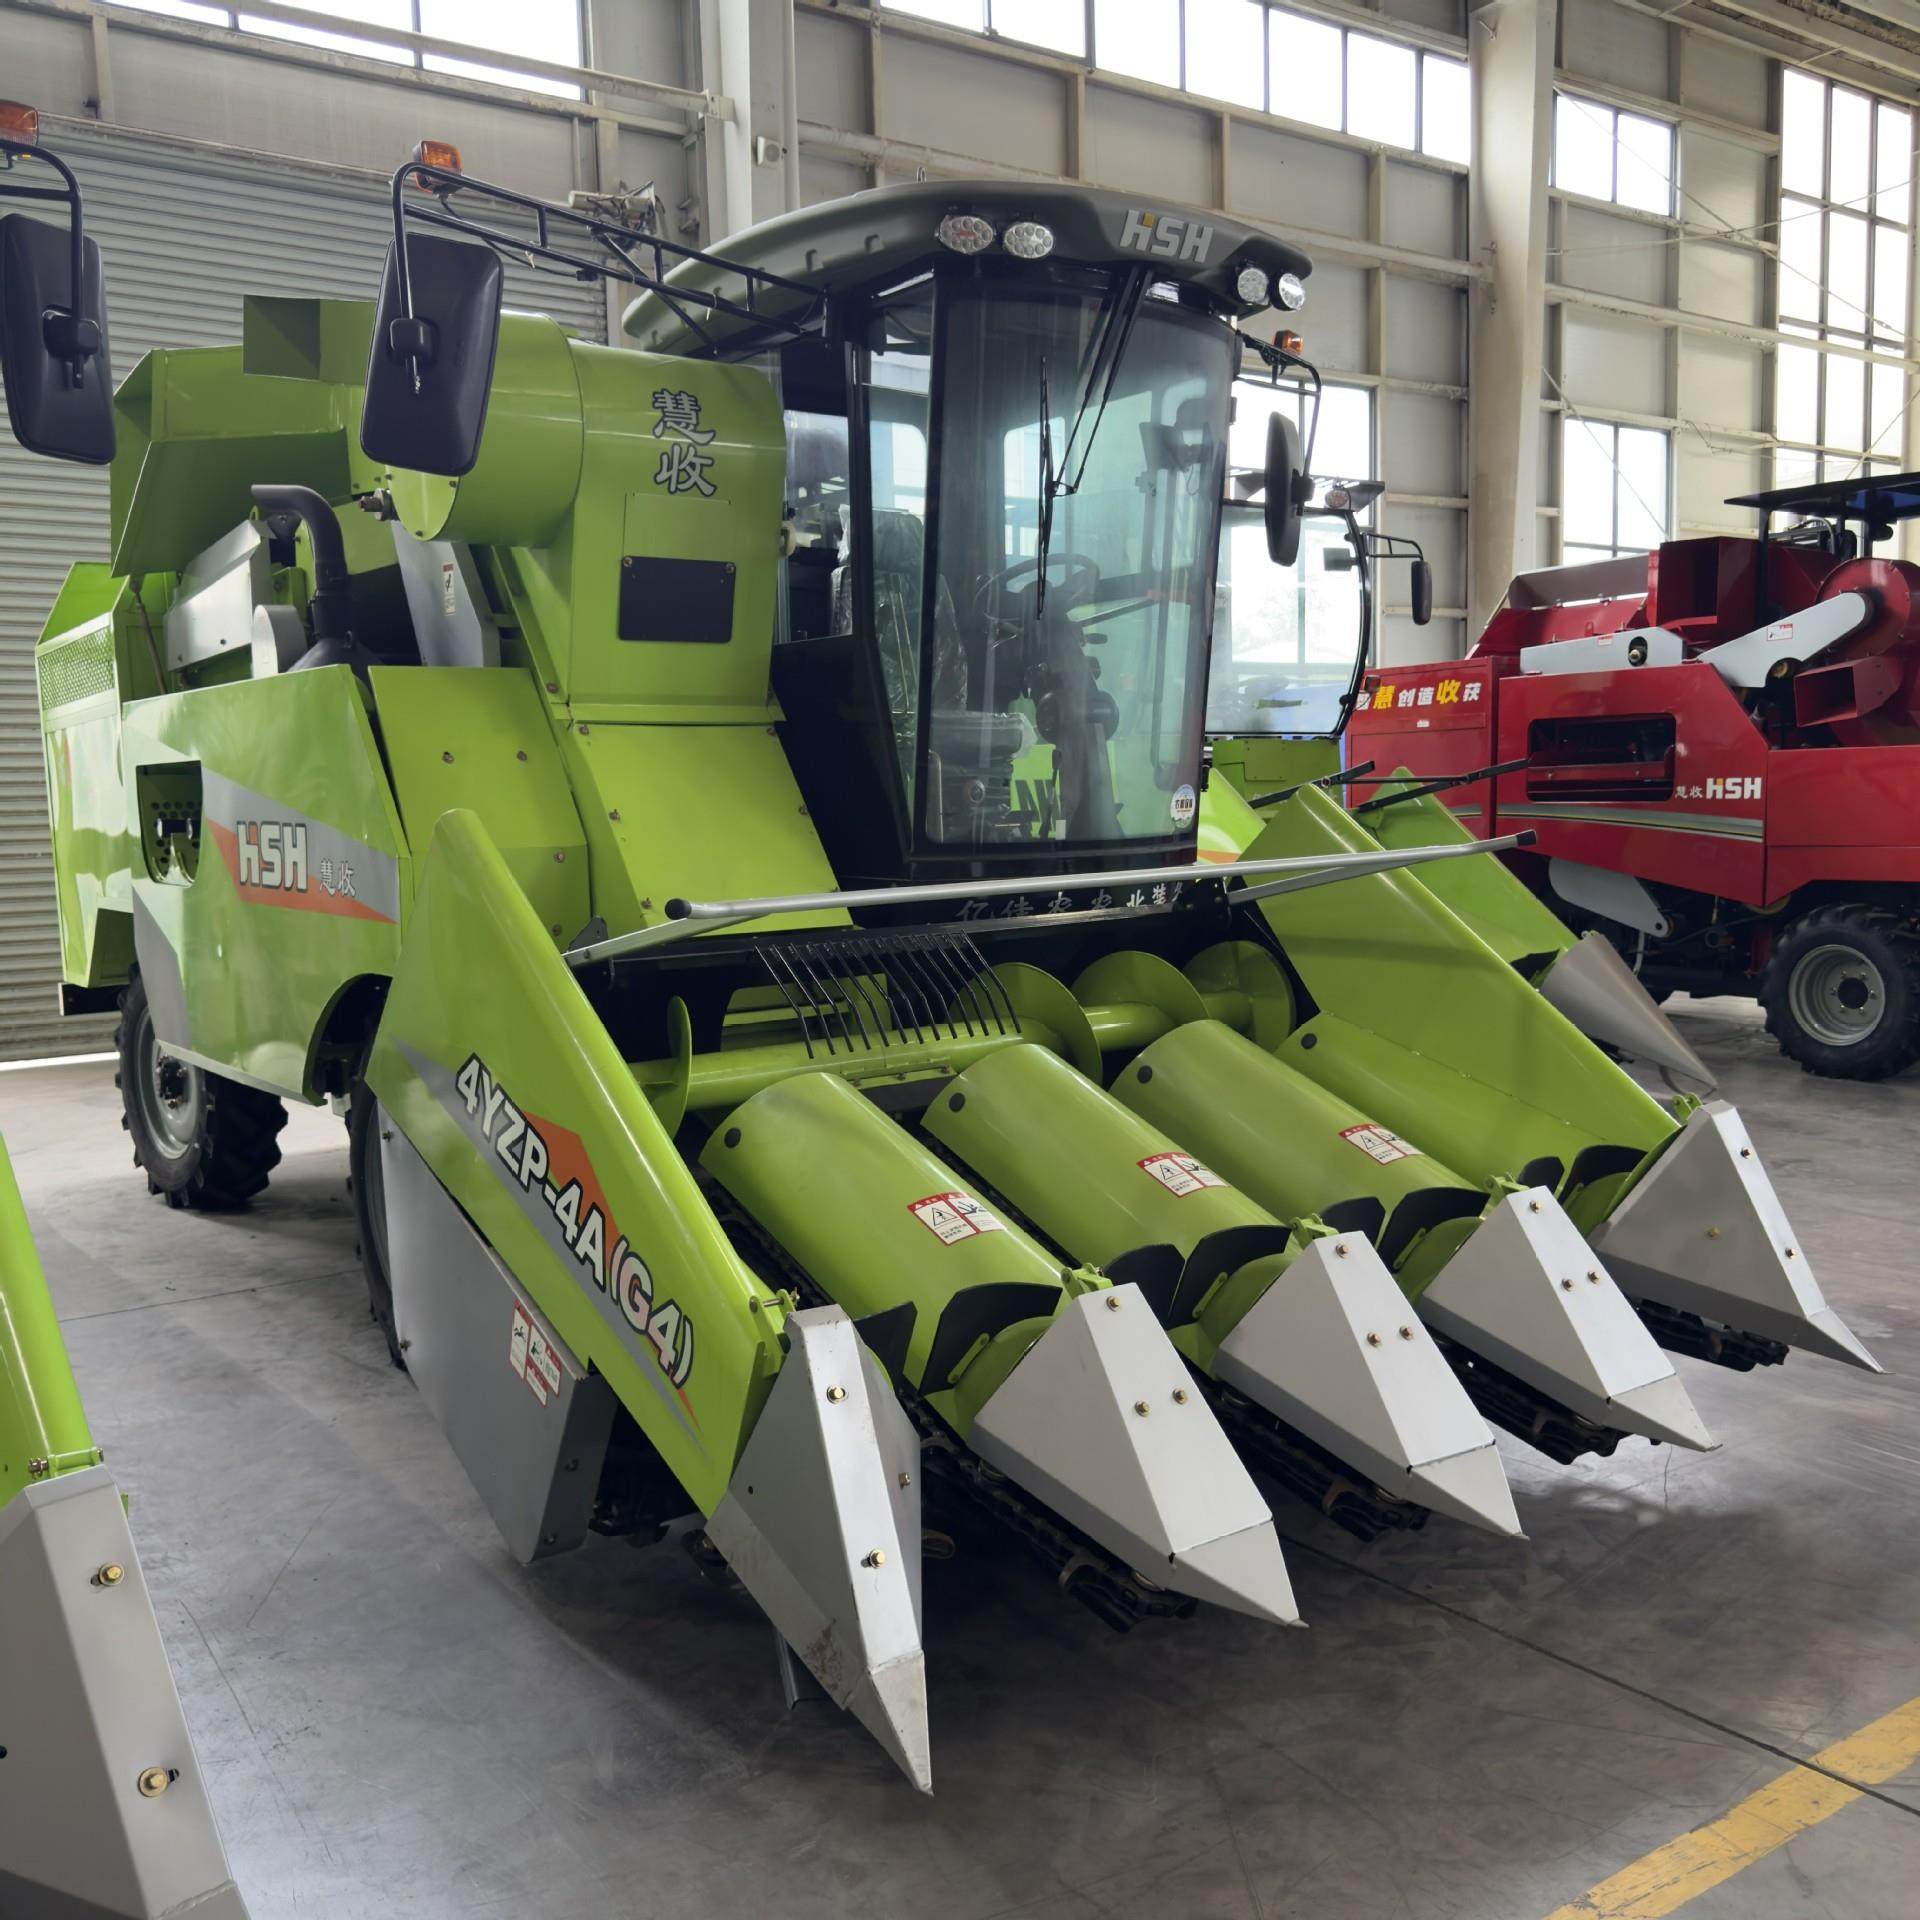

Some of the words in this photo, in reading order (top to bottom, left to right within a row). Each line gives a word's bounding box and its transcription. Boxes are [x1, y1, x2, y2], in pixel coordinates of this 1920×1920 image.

[1119, 208, 1214, 263] HSH
[652, 387, 717, 497] 慧收
[1706, 777, 1762, 799] HSH
[237, 820, 308, 893] HSH
[319, 857, 357, 897] 慧收
[455, 1052, 694, 1391] 4YZP-4A(G4)
